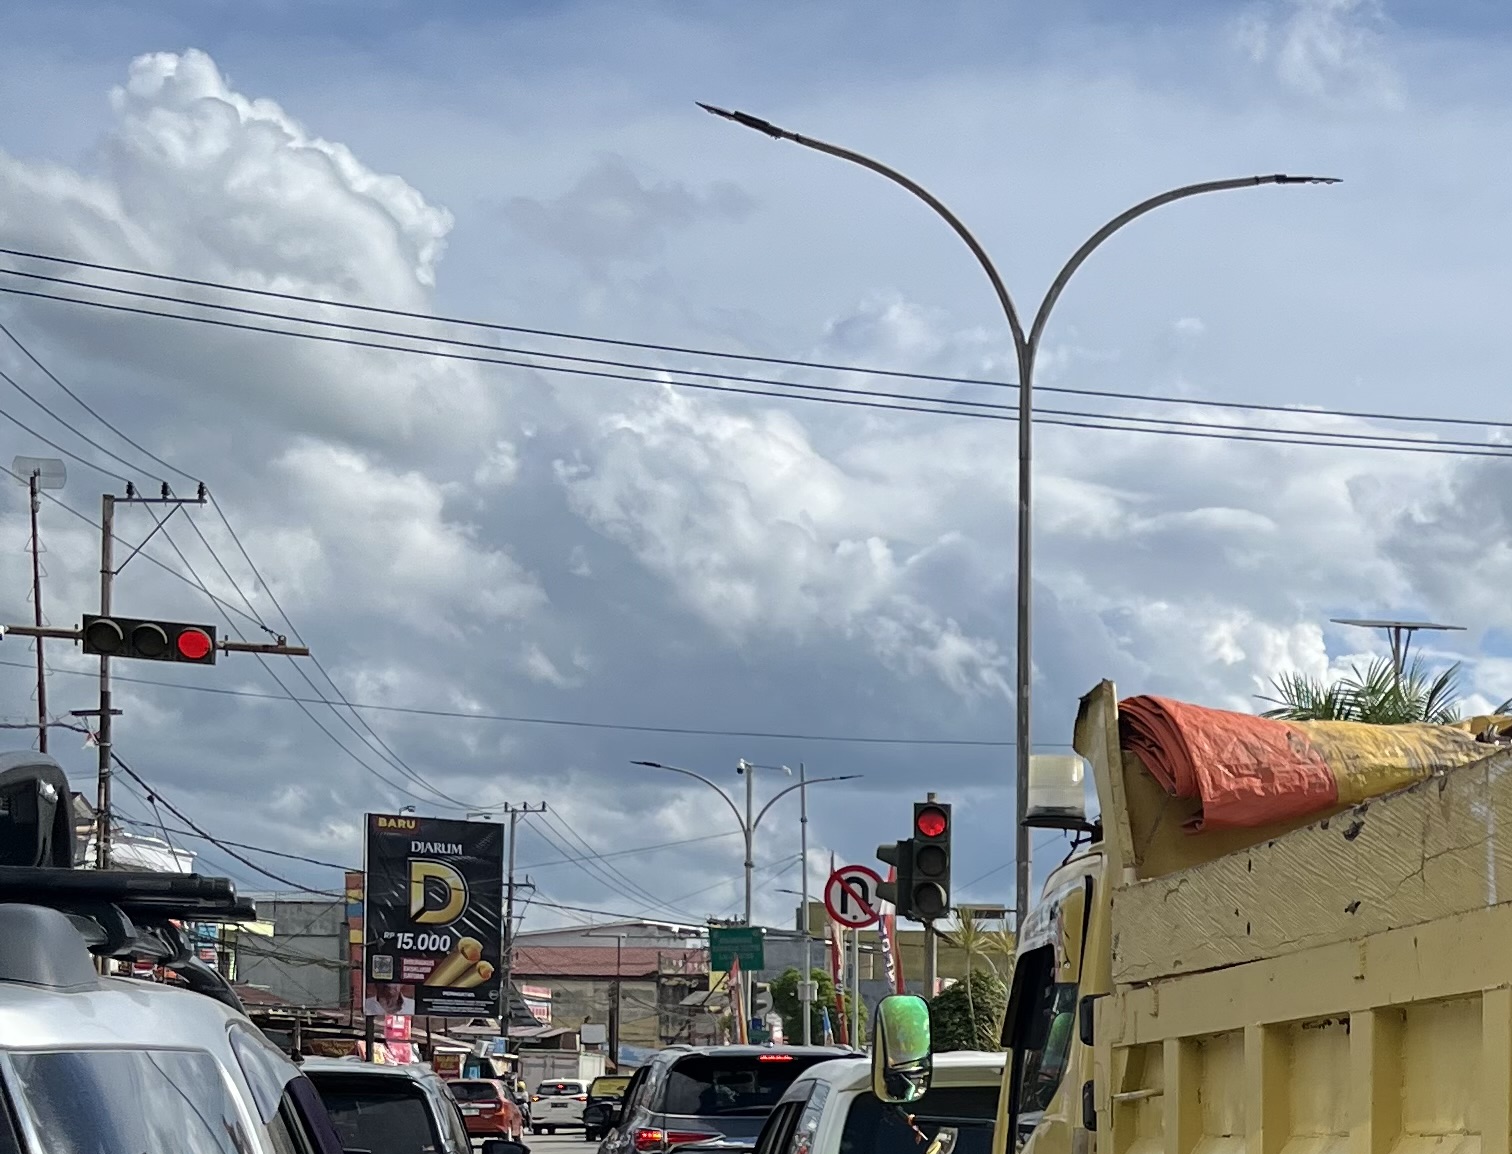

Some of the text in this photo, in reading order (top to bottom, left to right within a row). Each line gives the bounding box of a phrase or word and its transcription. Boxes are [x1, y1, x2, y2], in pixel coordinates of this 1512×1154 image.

[377, 816, 416, 829] BARU
[411, 840, 463, 855] DJARUM
[407, 857, 470, 928] D
[396, 932, 451, 952] 15.000
